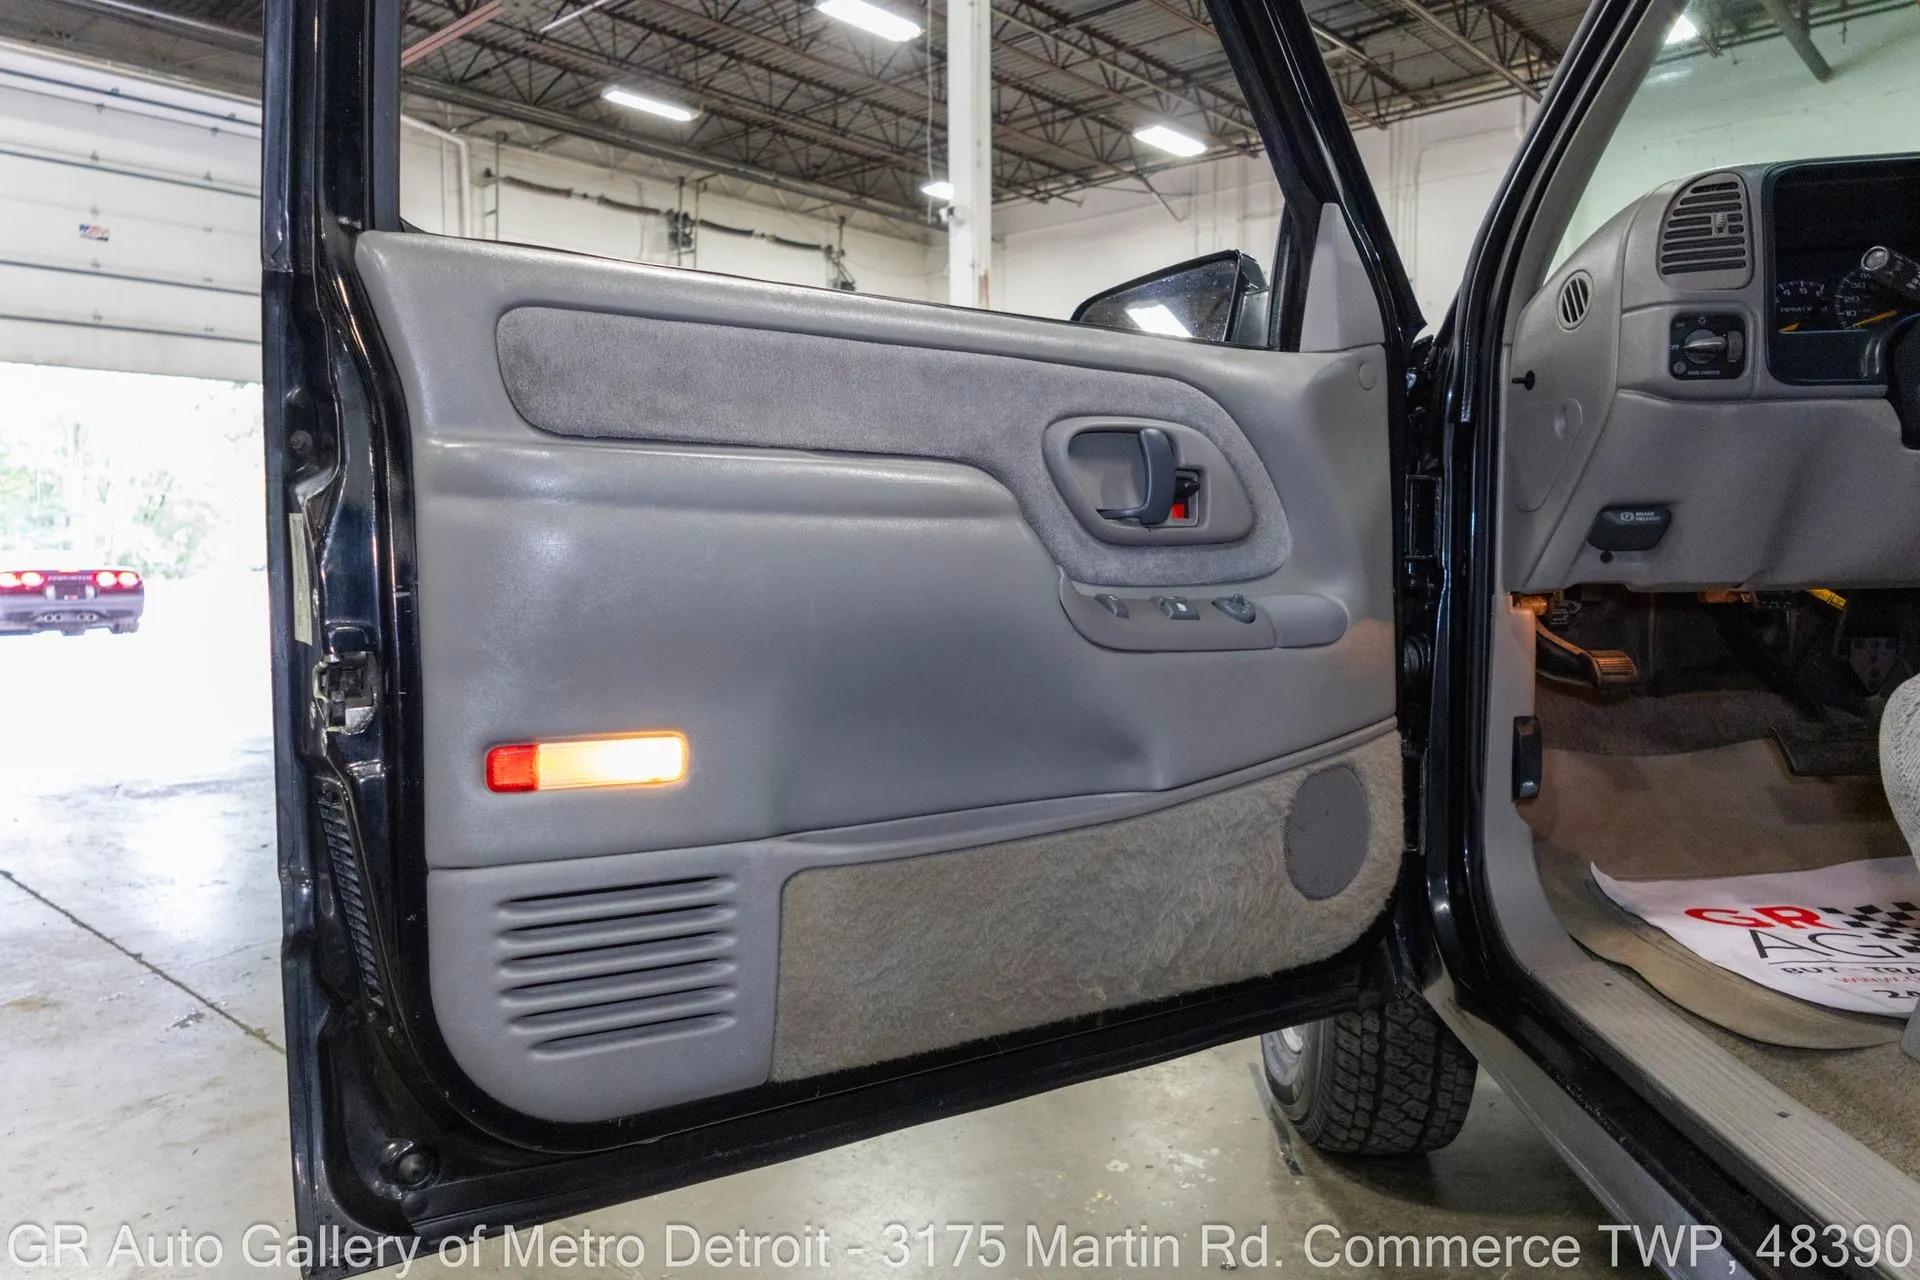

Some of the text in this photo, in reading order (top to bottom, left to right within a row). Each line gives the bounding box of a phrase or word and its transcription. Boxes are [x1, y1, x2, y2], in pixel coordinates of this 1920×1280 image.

[1684, 906, 1848, 931] GR
[1749, 929, 1905, 959] AG
[1782, 966, 1839, 974] BUY
